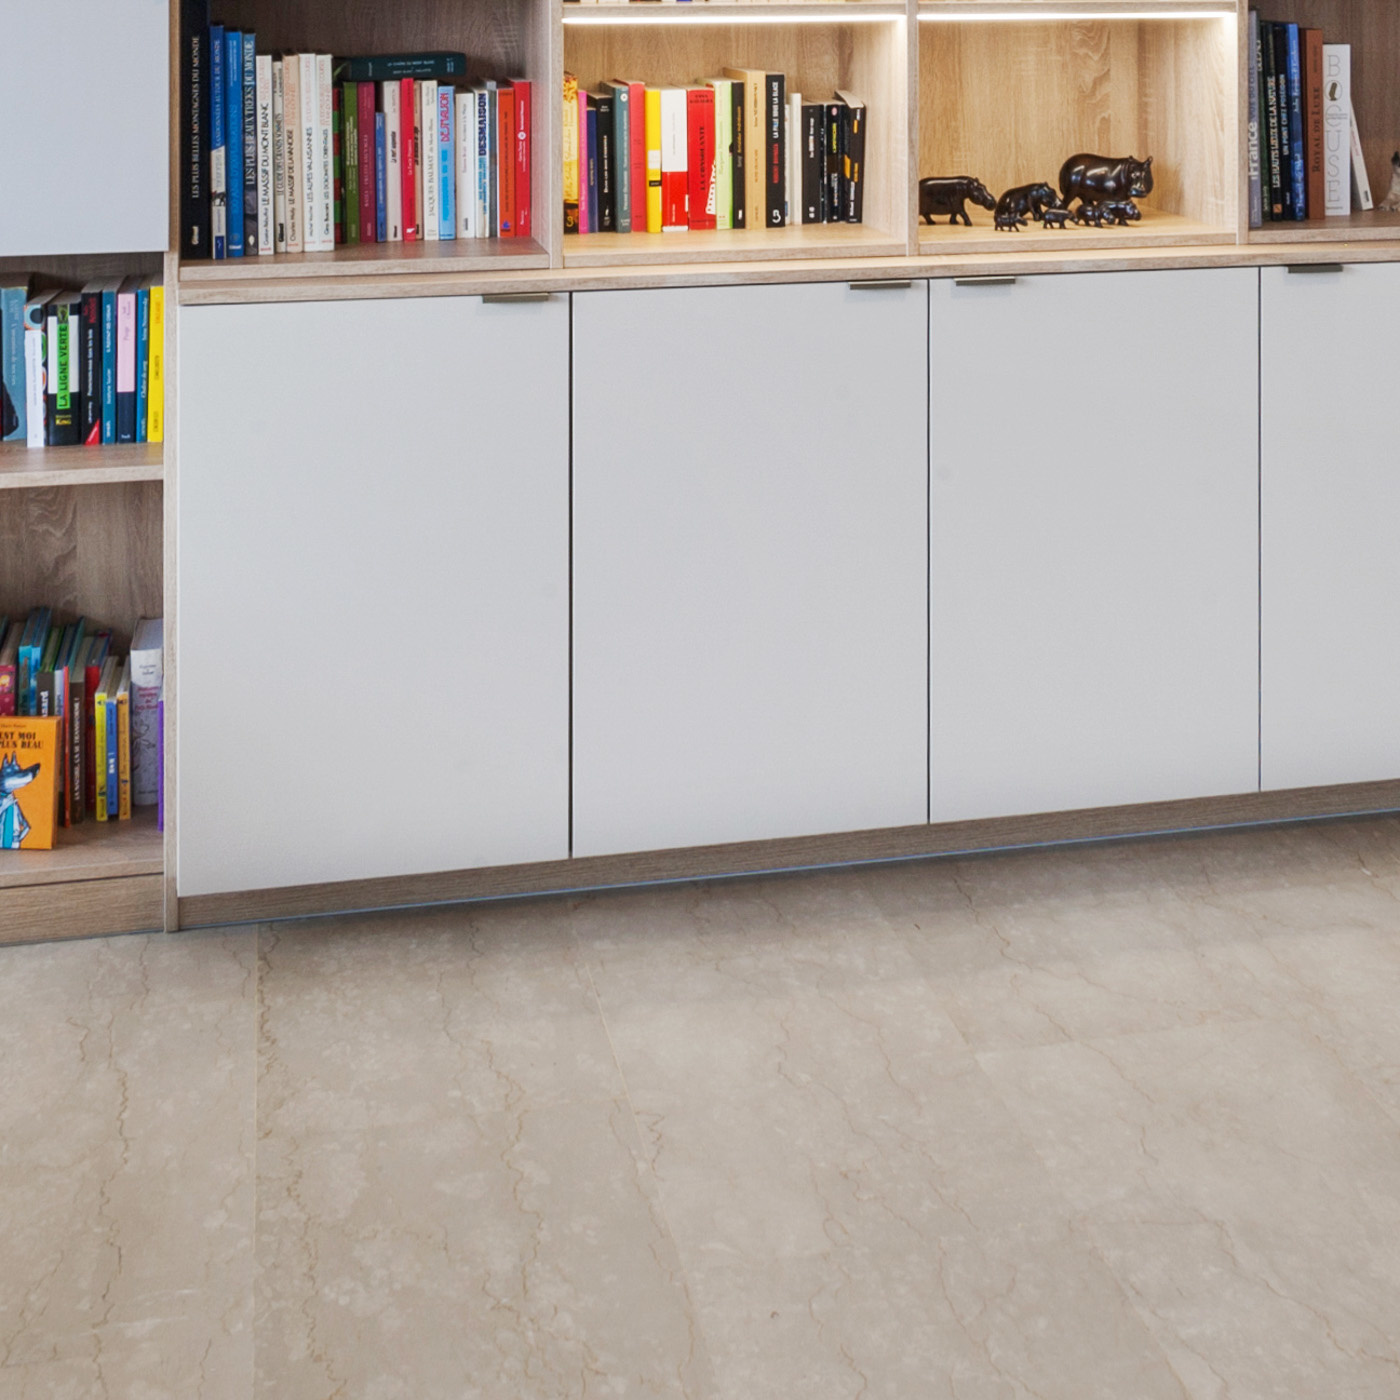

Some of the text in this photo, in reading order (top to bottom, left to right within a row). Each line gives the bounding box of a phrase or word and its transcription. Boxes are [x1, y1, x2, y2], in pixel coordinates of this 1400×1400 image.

[191, 36, 199, 67] MONDE
[243, 40, 254, 71] MONDE
[191, 70, 199, 81] DU
[191, 84, 199, 133] MONTAGNES
[260, 103, 269, 127] BLANC
[478, 94, 487, 156] DESMAISON
[260, 127, 269, 152] MONT
[260, 154, 269, 167] DU
[260, 168, 269, 195] MASSIF
[261, 196, 269, 206] LE
[58, 326, 67, 406] LA LIGNE VERTE
